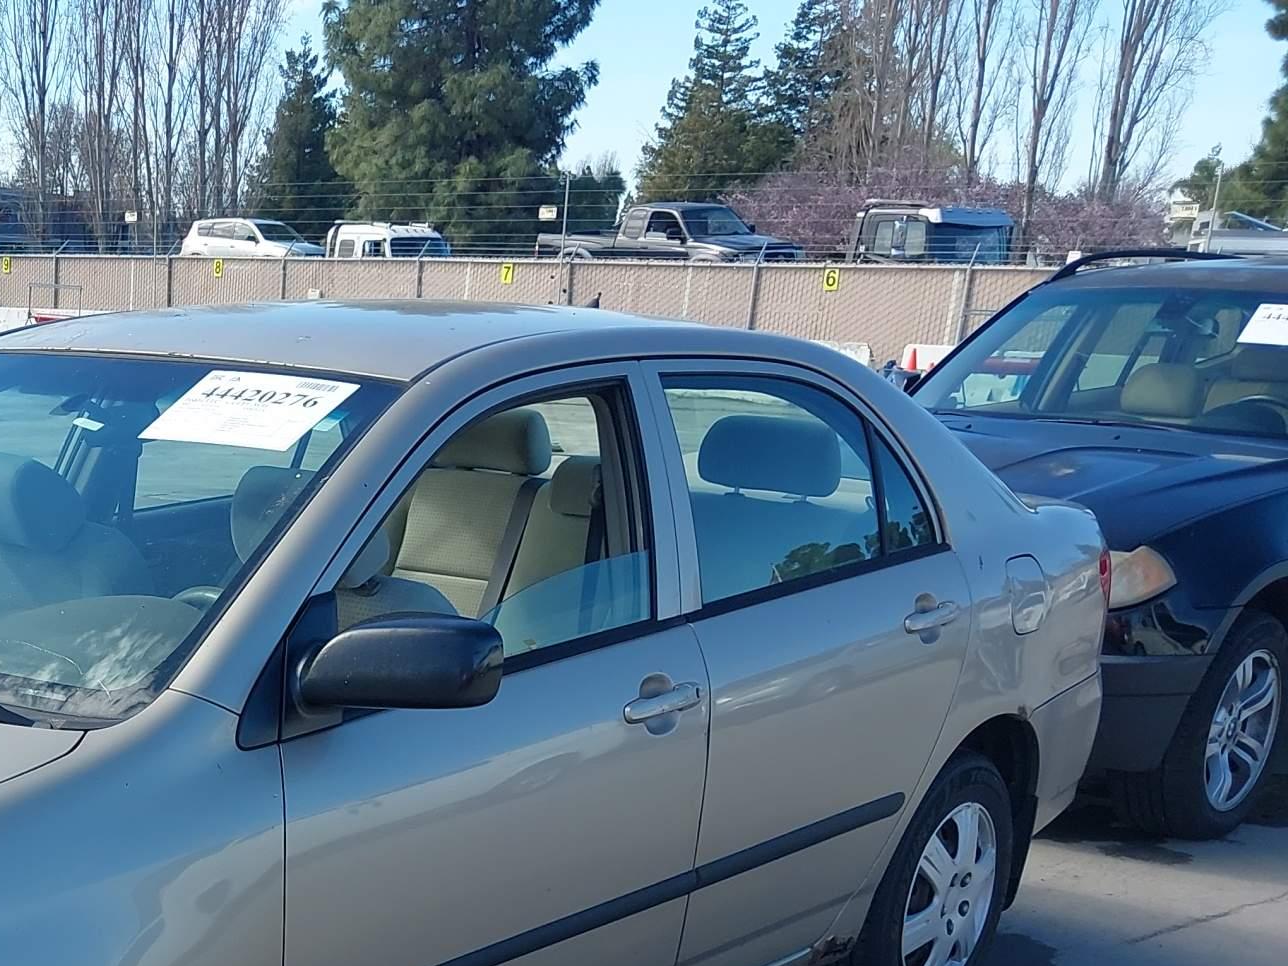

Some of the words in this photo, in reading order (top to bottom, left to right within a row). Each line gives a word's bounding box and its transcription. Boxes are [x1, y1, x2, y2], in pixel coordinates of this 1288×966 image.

[4, 259, 9, 271] 9
[215, 261, 221, 274] 8
[504, 266, 511, 281] 7
[826, 270, 836, 287] 6
[201, 386, 320, 408] 44420276
